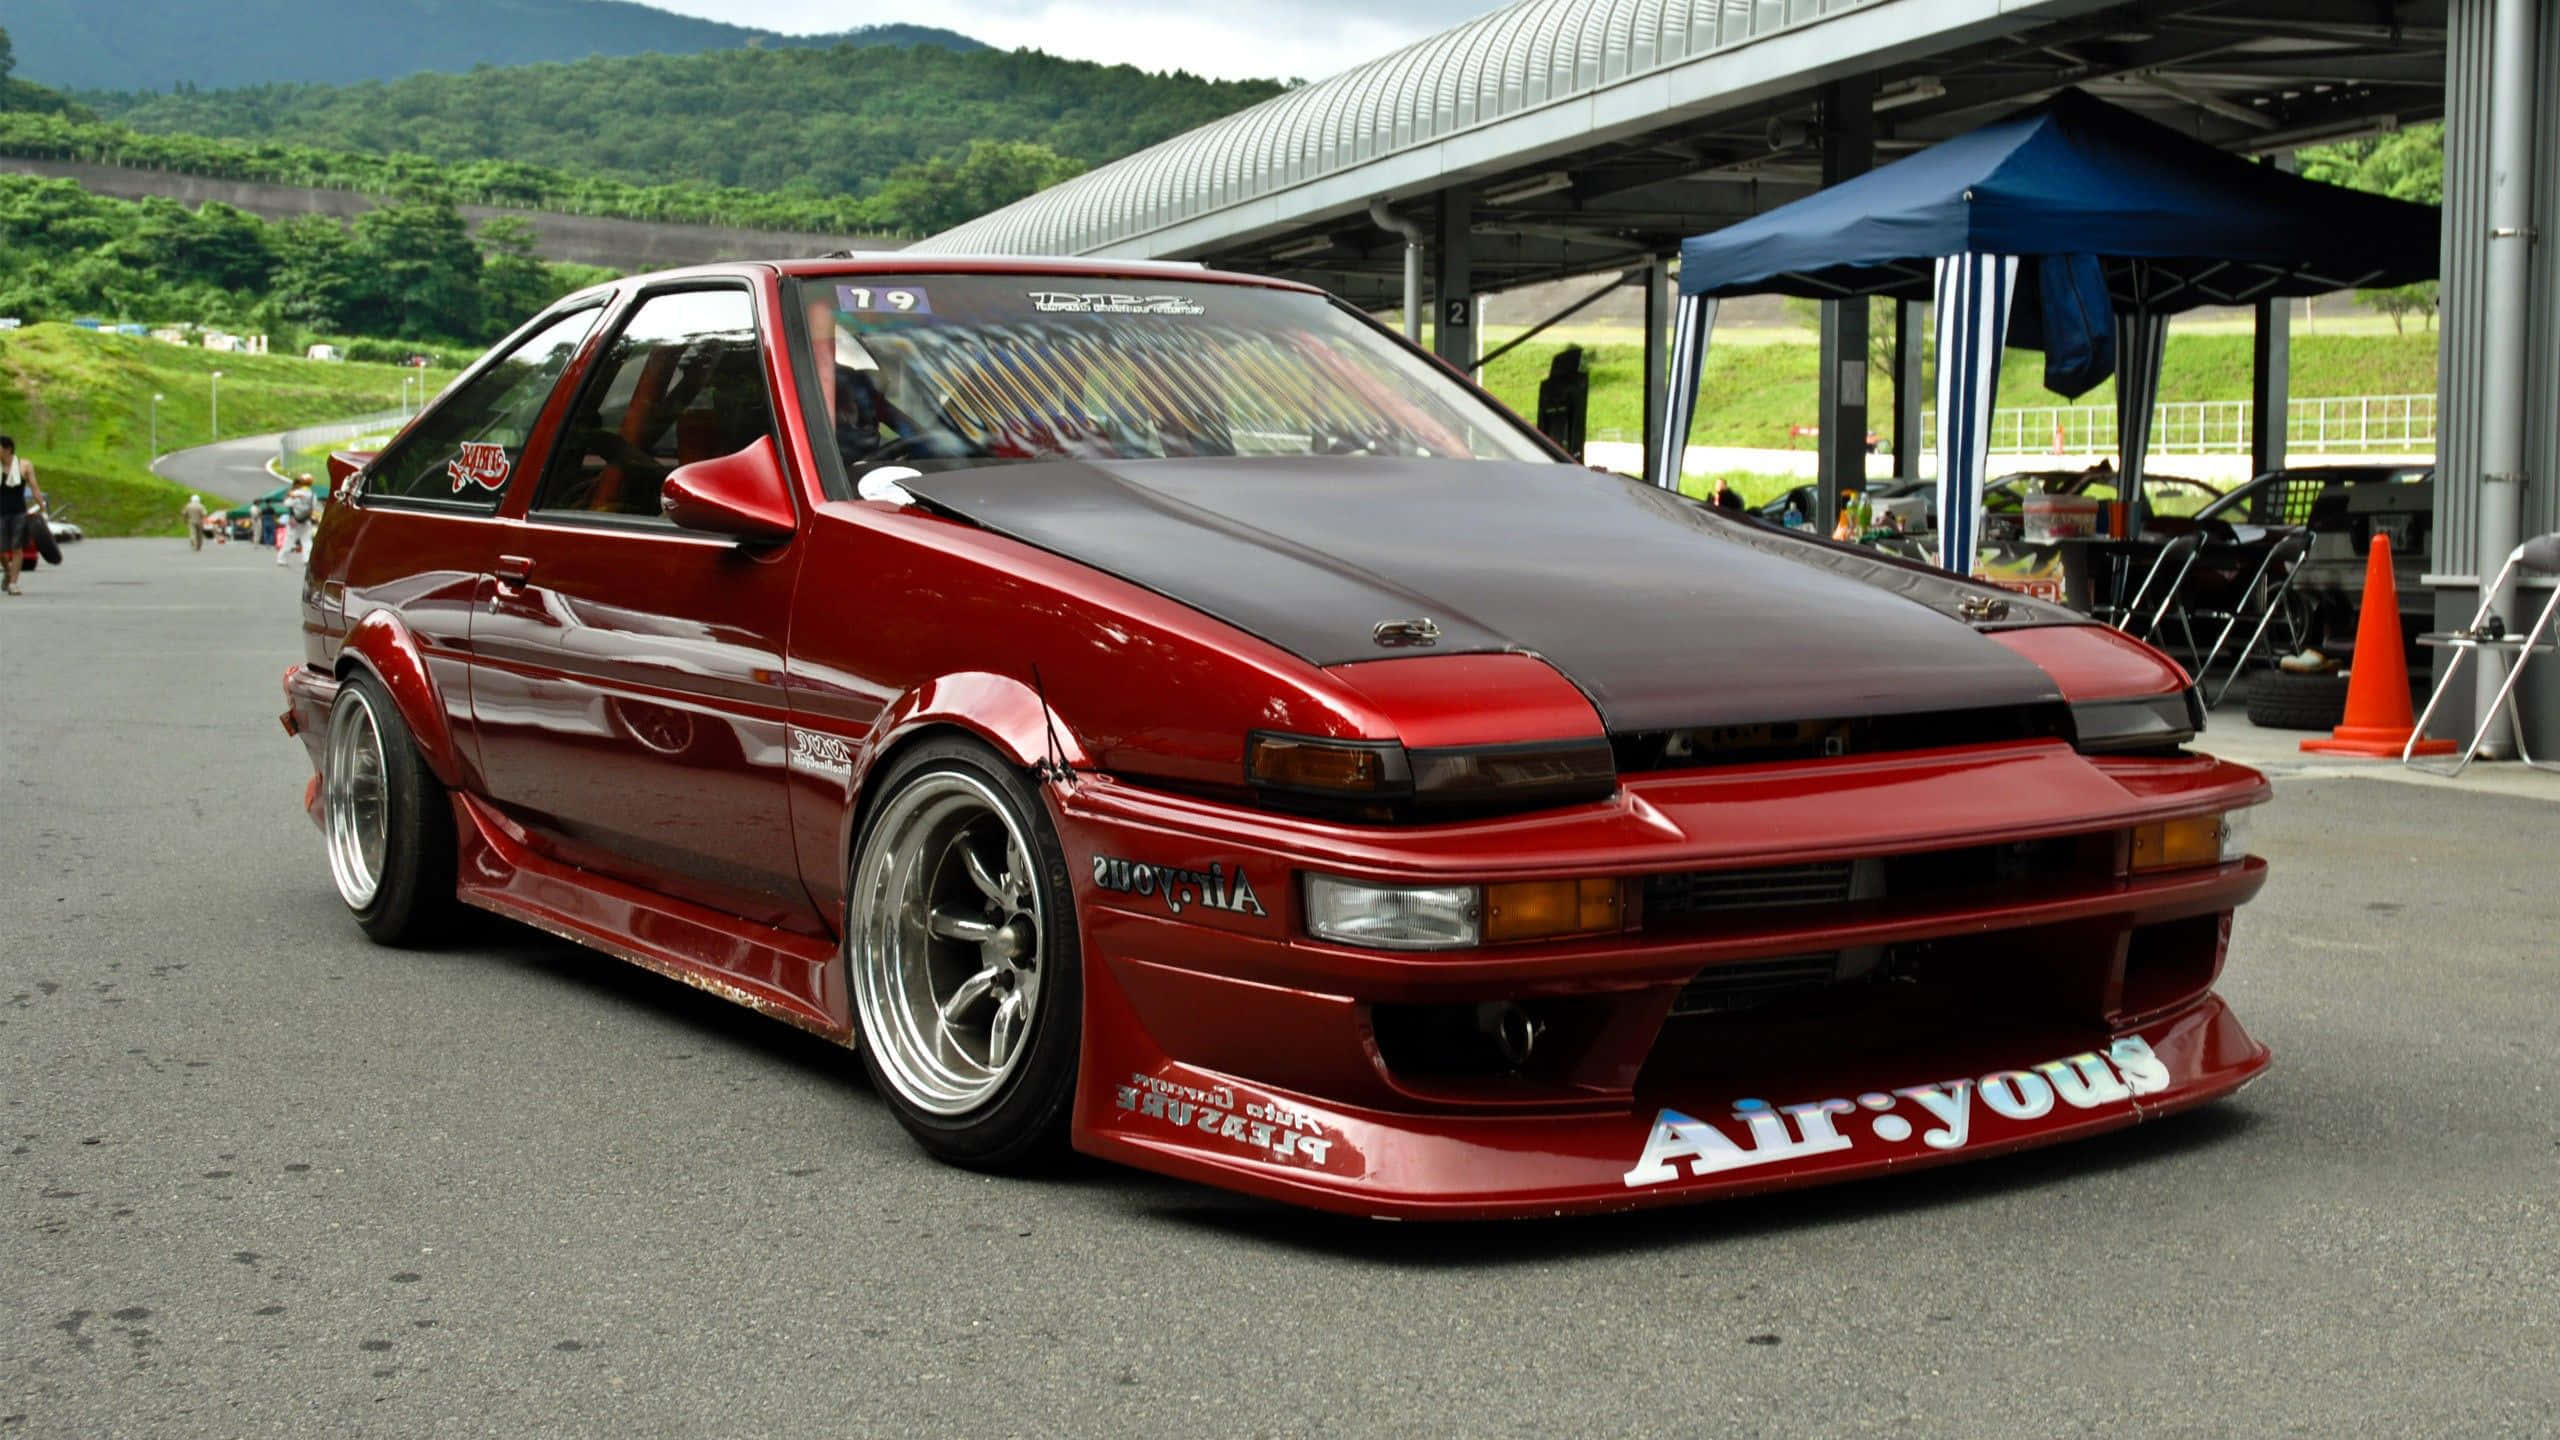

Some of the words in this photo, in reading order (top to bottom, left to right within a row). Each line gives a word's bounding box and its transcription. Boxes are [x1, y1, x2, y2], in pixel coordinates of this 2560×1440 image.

[850, 288, 915, 310] 19
[1450, 301, 1465, 324] 2
[1623, 1034, 2171, 1188] Air:yous
